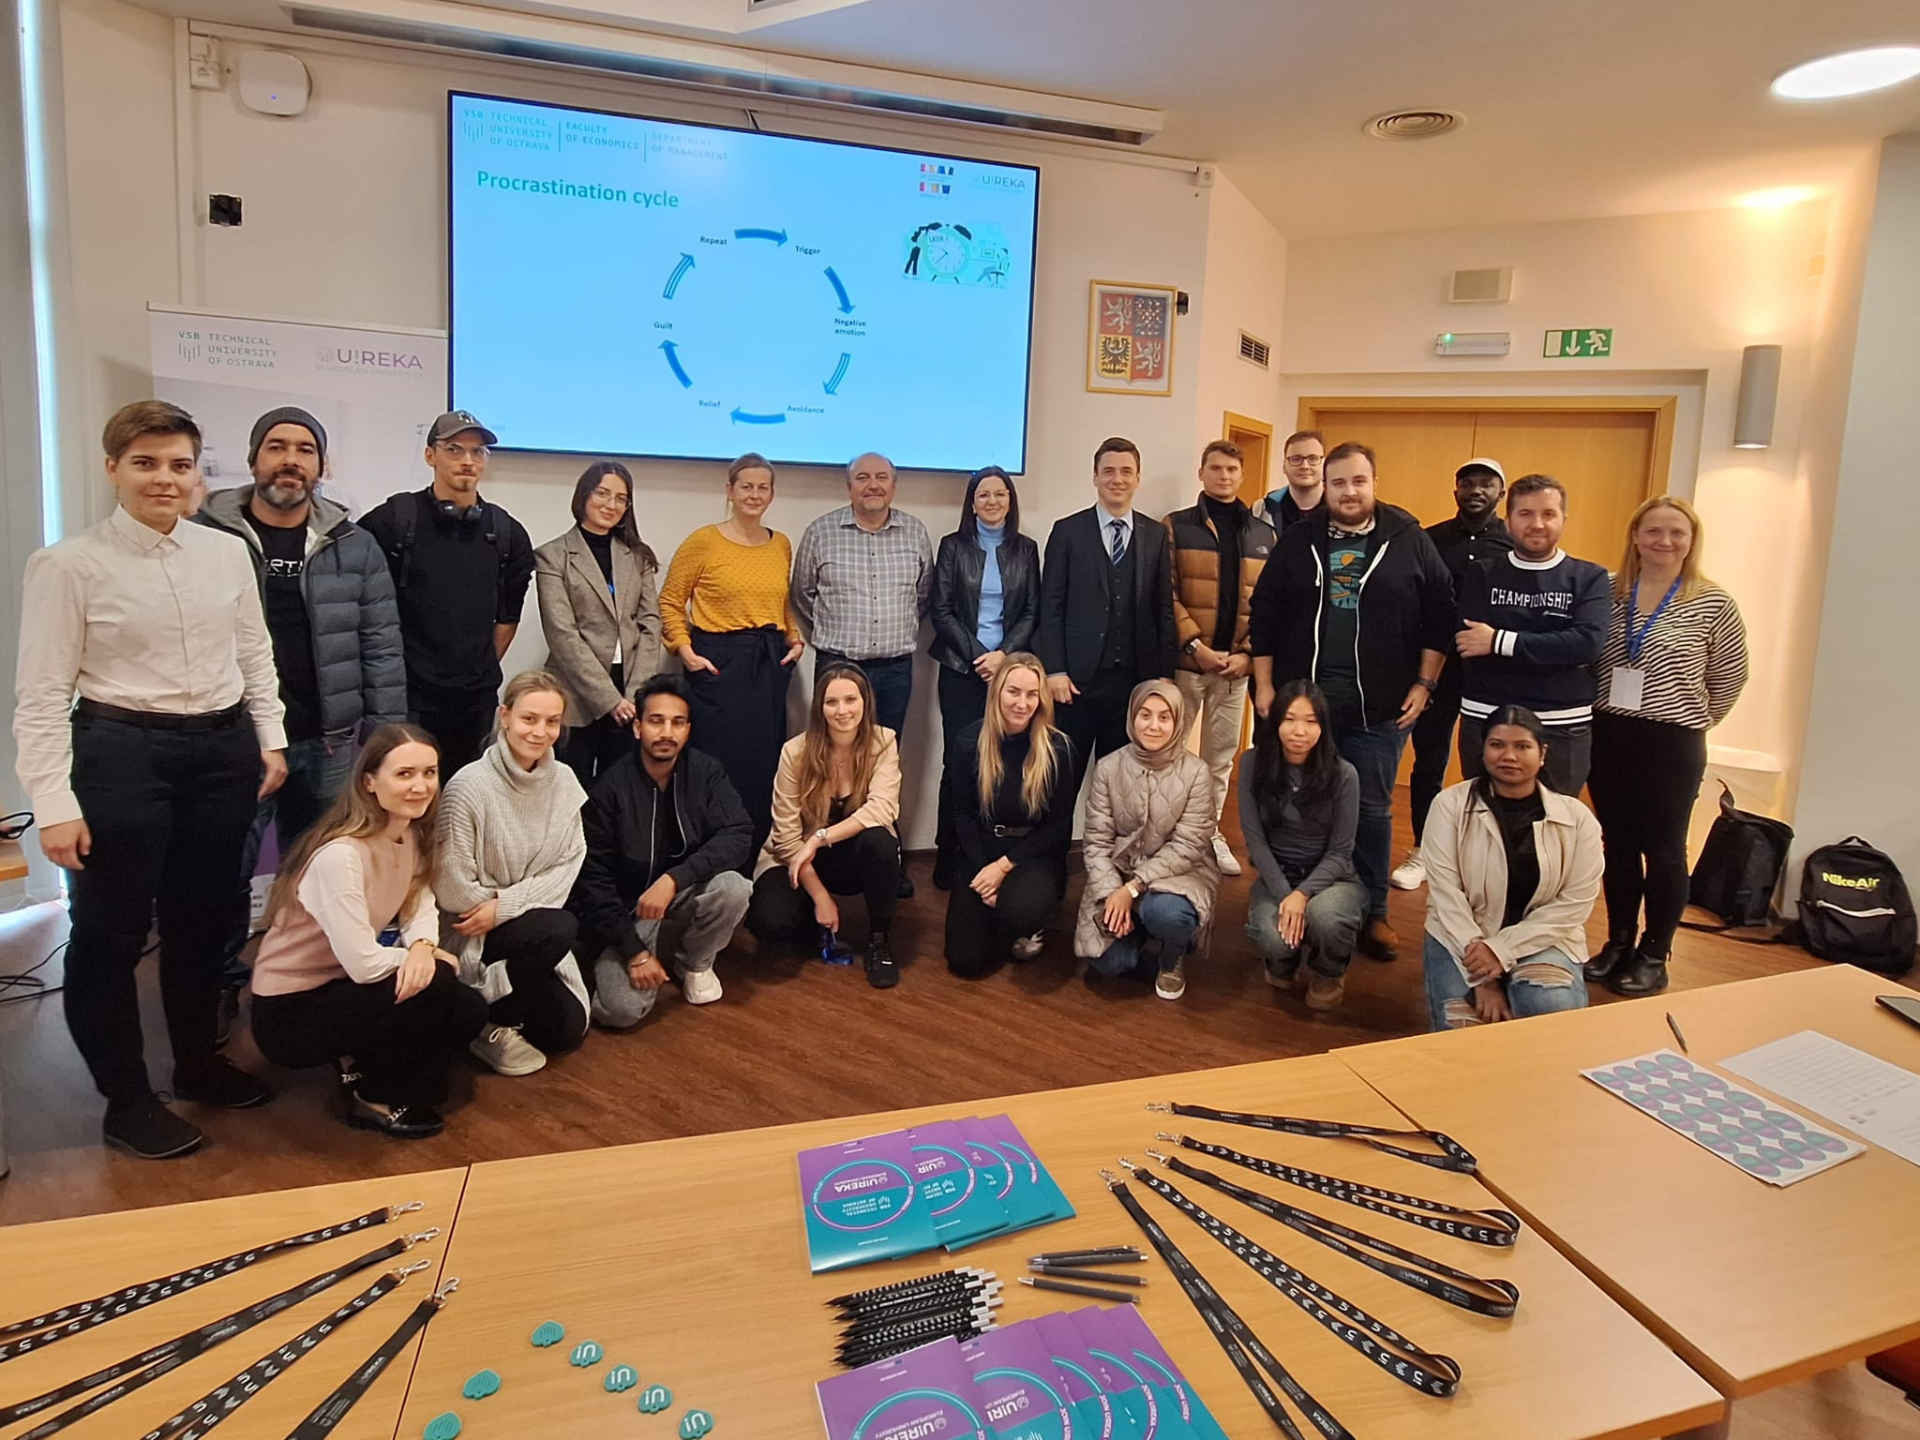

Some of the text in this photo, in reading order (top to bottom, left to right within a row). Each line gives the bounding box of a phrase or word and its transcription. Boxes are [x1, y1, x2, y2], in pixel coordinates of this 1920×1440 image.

[464, 108, 547, 127] VSB TECHNICAL
[490, 124, 552, 139] UNIVERSITY
[566, 122, 608, 134] FACULTY
[490, 137, 550, 151] OF OSTRAVA
[566, 134, 639, 150] OF ECONOMICS
[477, 170, 679, 208] Procrastination cycle
[700, 235, 728, 246] Repeat
[795, 245, 821, 255] Trigger
[653, 321, 673, 330] Guilt
[834, 317, 866, 328] Negative
[178, 331, 271, 346] VSB TECHNICAL
[834, 328, 866, 337] emotion
[208, 345, 278, 357] UNIVERSITY
[208, 356, 275, 368] OF OSTRAVA
[337, 348, 424, 370] U!REKA
[698, 400, 721, 408] Relief
[786, 405, 825, 414] Avoidance
[1490, 587, 1574, 610] CHAMPIONSHIP
